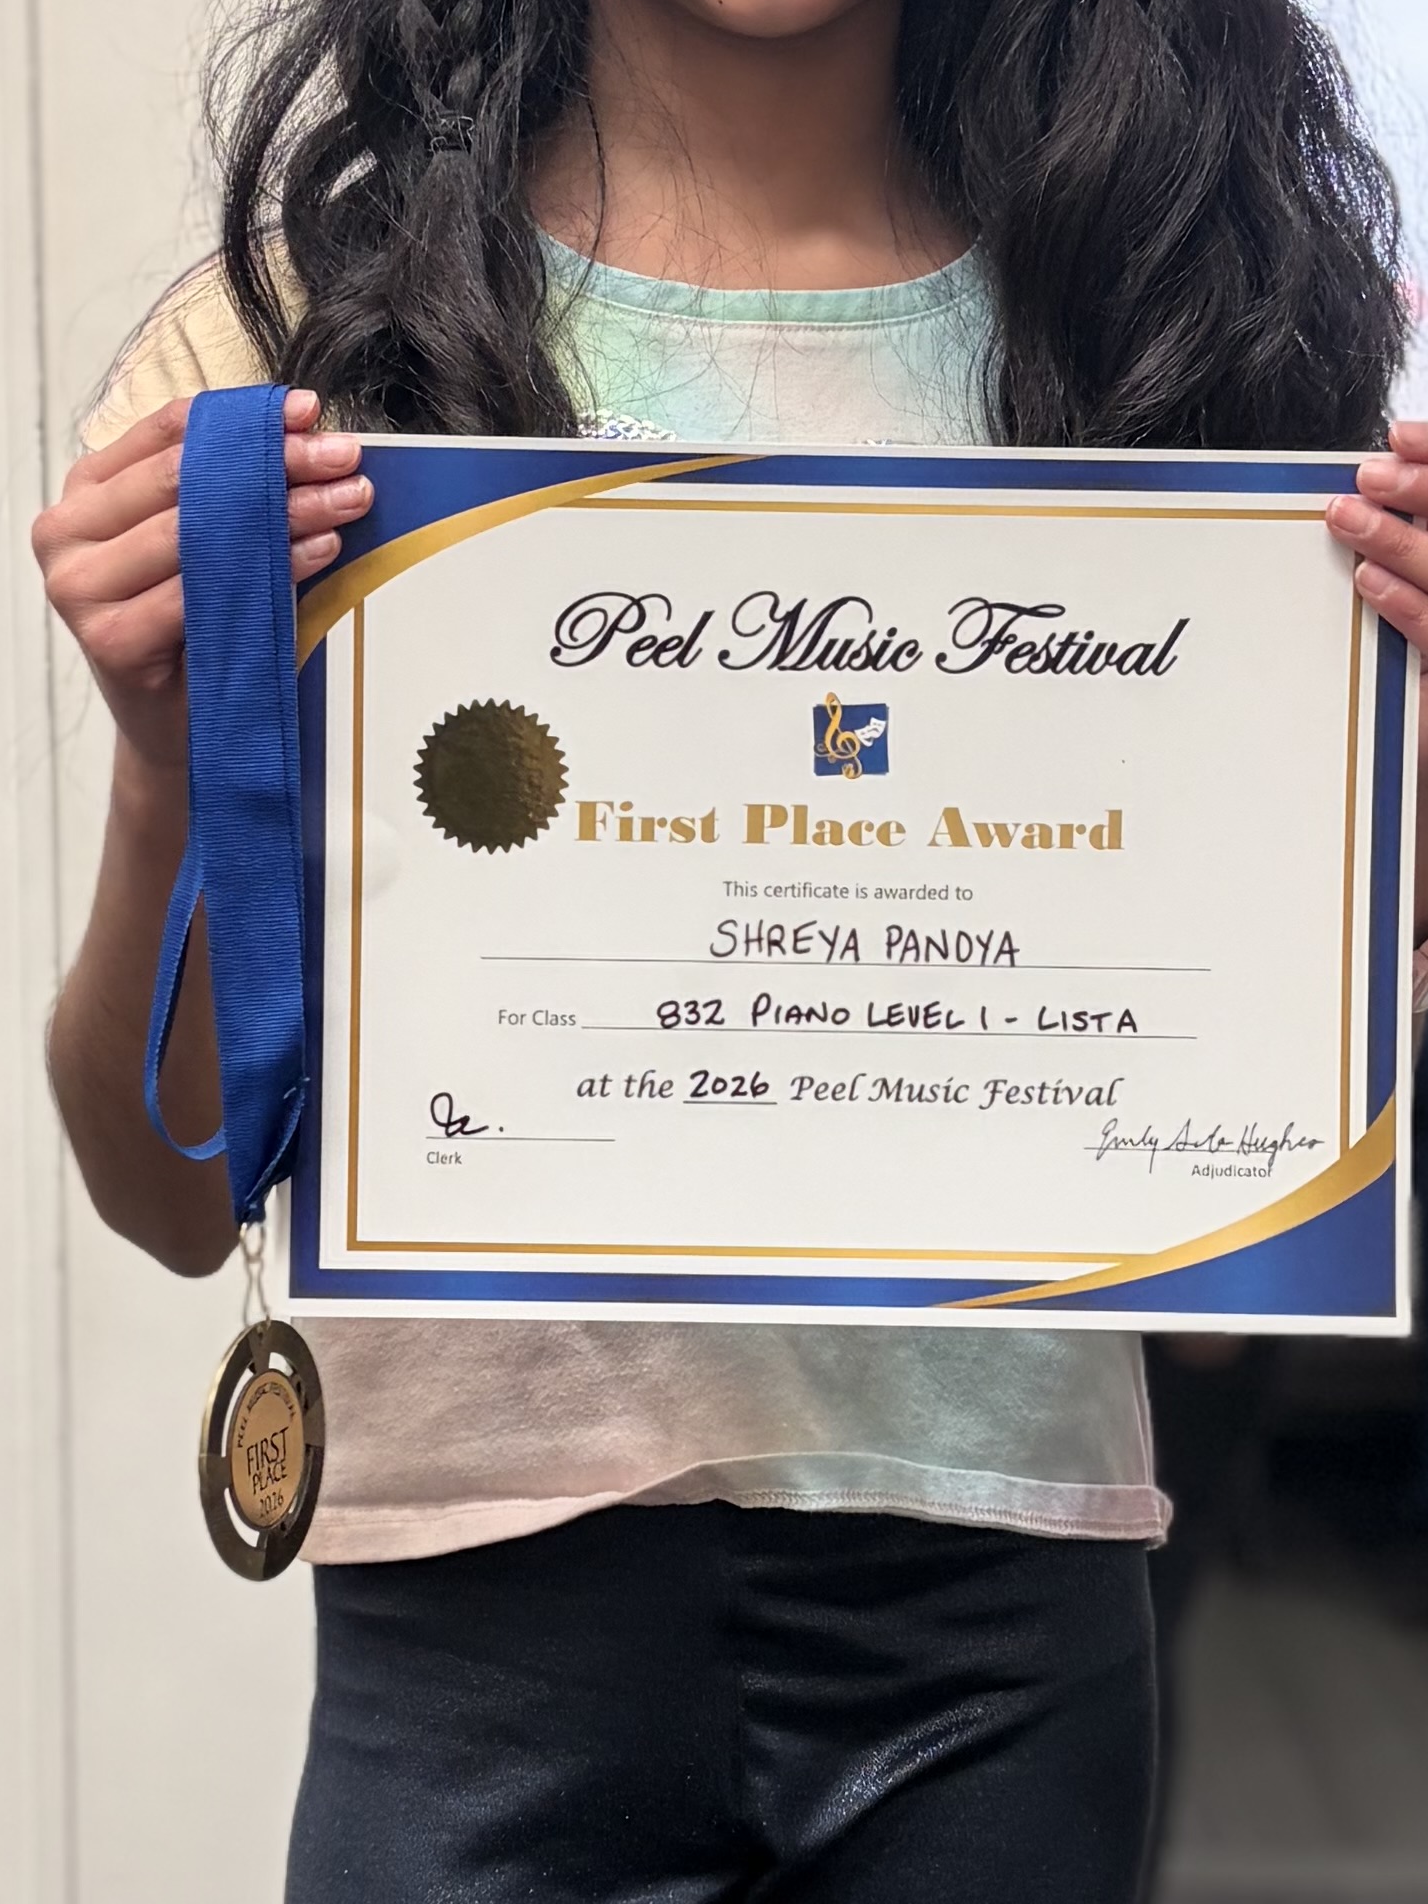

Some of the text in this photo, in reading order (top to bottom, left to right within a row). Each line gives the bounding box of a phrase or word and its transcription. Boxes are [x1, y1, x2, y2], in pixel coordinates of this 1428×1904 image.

[549, 590, 1191, 677] Peel Music Festival
[574, 799, 1125, 851] First Place Award
[722, 880, 974, 902] This certificate is awarded to
[709, 918, 1021, 967] SHREYA PANDYA
[498, 1008, 527, 1026] For
[531, 1008, 577, 1027] Class
[656, 999, 726, 1029] 832
[750, 992, 851, 1028] PIANO
[867, 1000, 966, 1030] LEVEL
[576, 1069, 1125, 1110] at the 2026 Peel Music Festival
[426, 1151, 463, 1165] Clerk
[1191, 1164, 1274, 1180] Adjudicator
[246, 1426, 290, 1477] FIRST
[251, 1462, 289, 1495] PLACE
